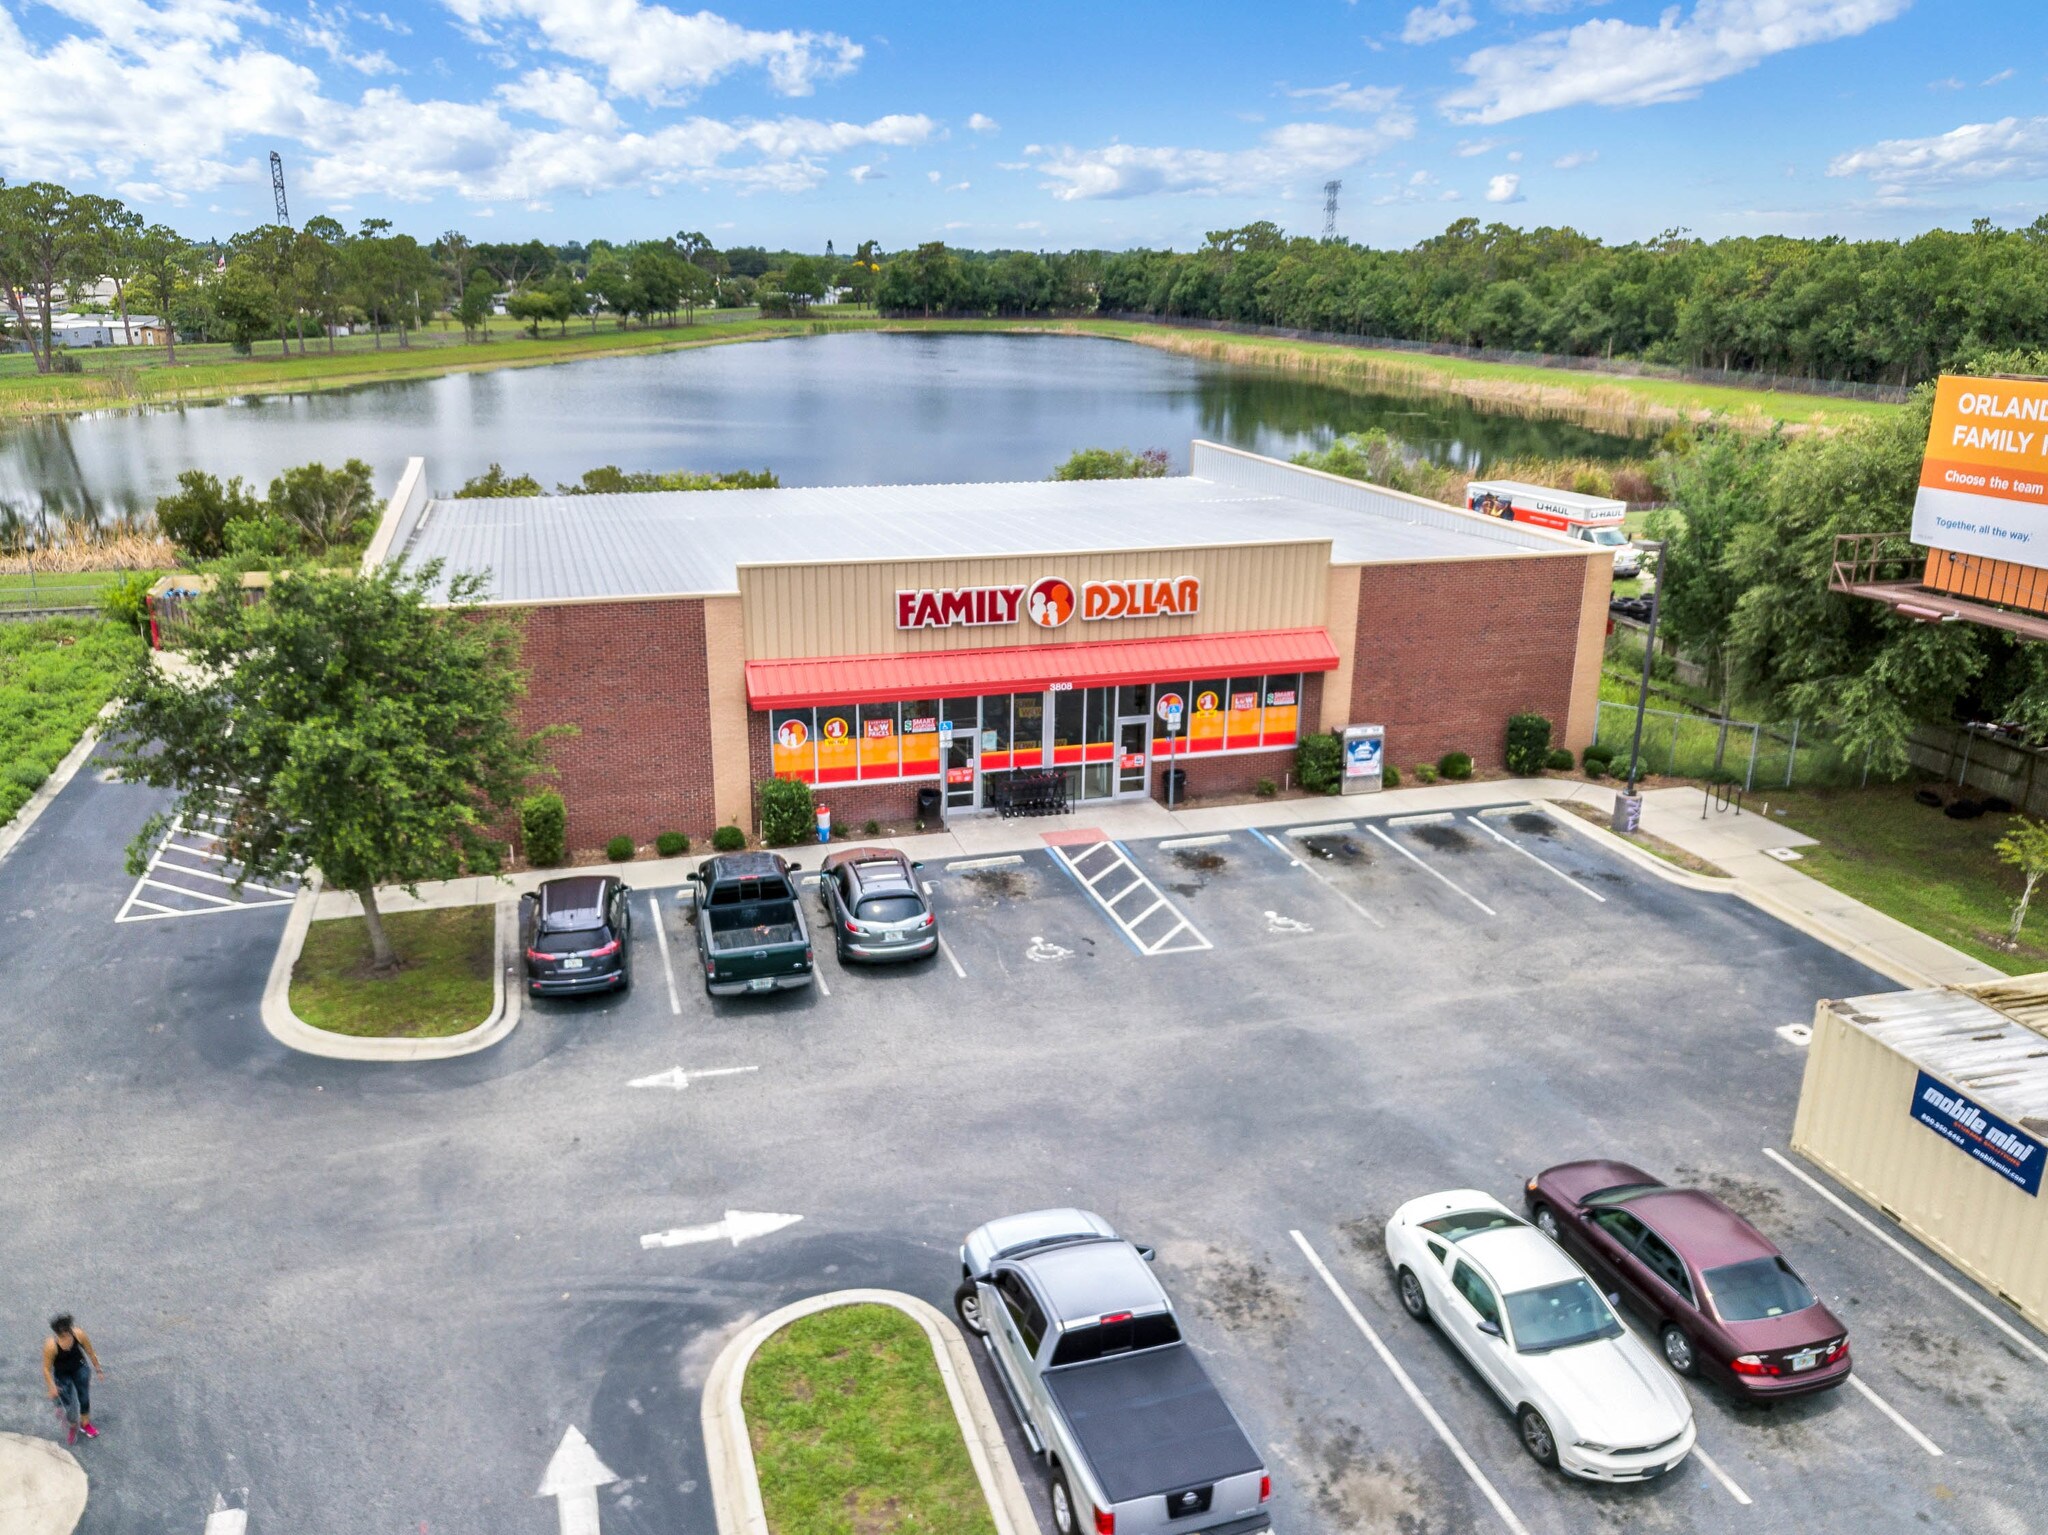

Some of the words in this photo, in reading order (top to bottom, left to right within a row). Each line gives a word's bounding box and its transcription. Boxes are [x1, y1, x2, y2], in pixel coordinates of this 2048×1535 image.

[1952, 425, 2034, 454] FAMILY
[1945, 469, 1986, 487] Choose
[1989, 476, 2009, 490] the
[2013, 481, 2044, 495] team
[1936, 517, 1977, 533] Together,
[1979, 525, 1990, 534] all
[1992, 528, 2007, 538] the
[2009, 532, 2031, 543] way.
[896, 585, 1026, 629] FAMILY
[1081, 575, 1199, 620] DOLLAR
[1049, 682, 1073, 692] 3808
[1922, 1087, 1987, 1135] mobile
[1985, 1126, 2035, 1162] mini
[1972, 1148, 2026, 1185] mobilemini.com
